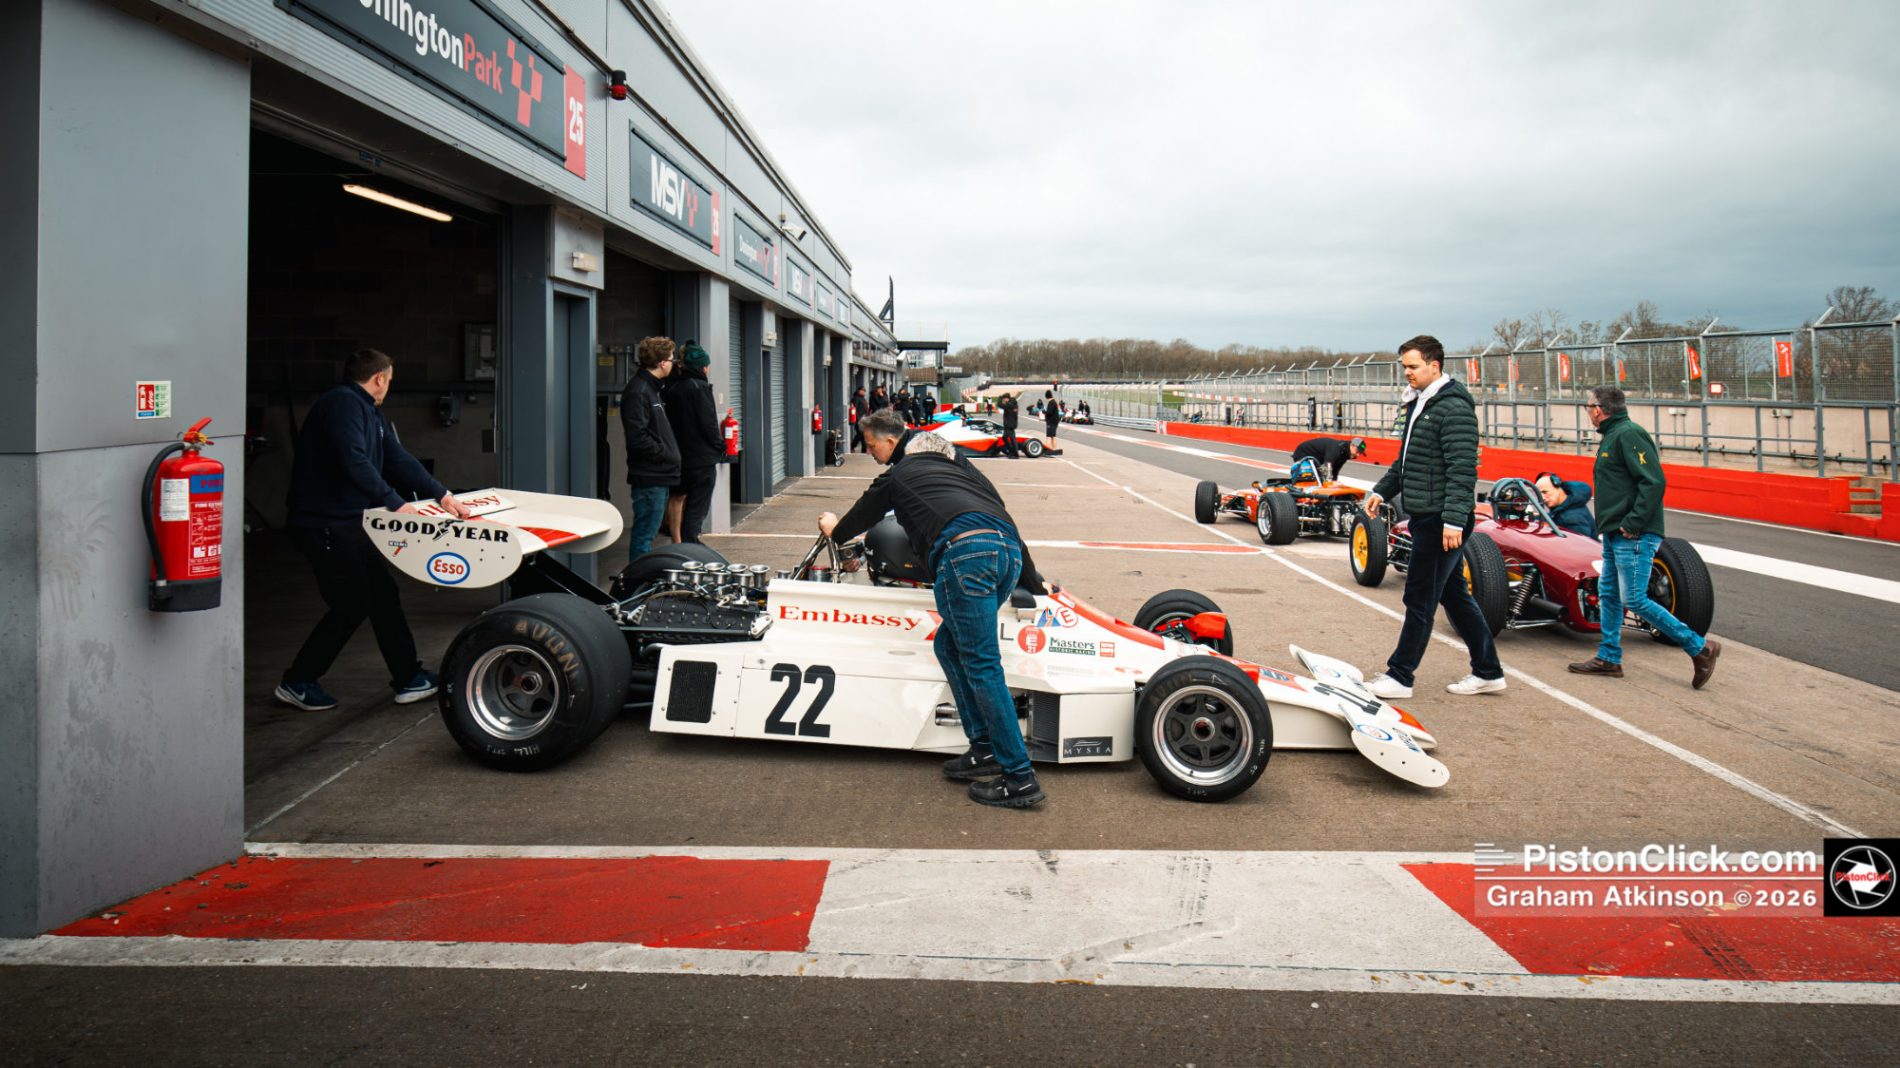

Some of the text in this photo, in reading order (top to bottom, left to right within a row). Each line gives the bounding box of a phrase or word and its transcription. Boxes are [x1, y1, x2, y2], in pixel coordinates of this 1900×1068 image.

[569, 97, 583, 145] 25
[651, 154, 685, 221] MSV
[434, 560, 464, 575] Esso
[779, 605, 922, 631] Embassy
[1060, 610, 1074, 623] E
[1050, 636, 1094, 650] Masters
[764, 663, 836, 738] 22
